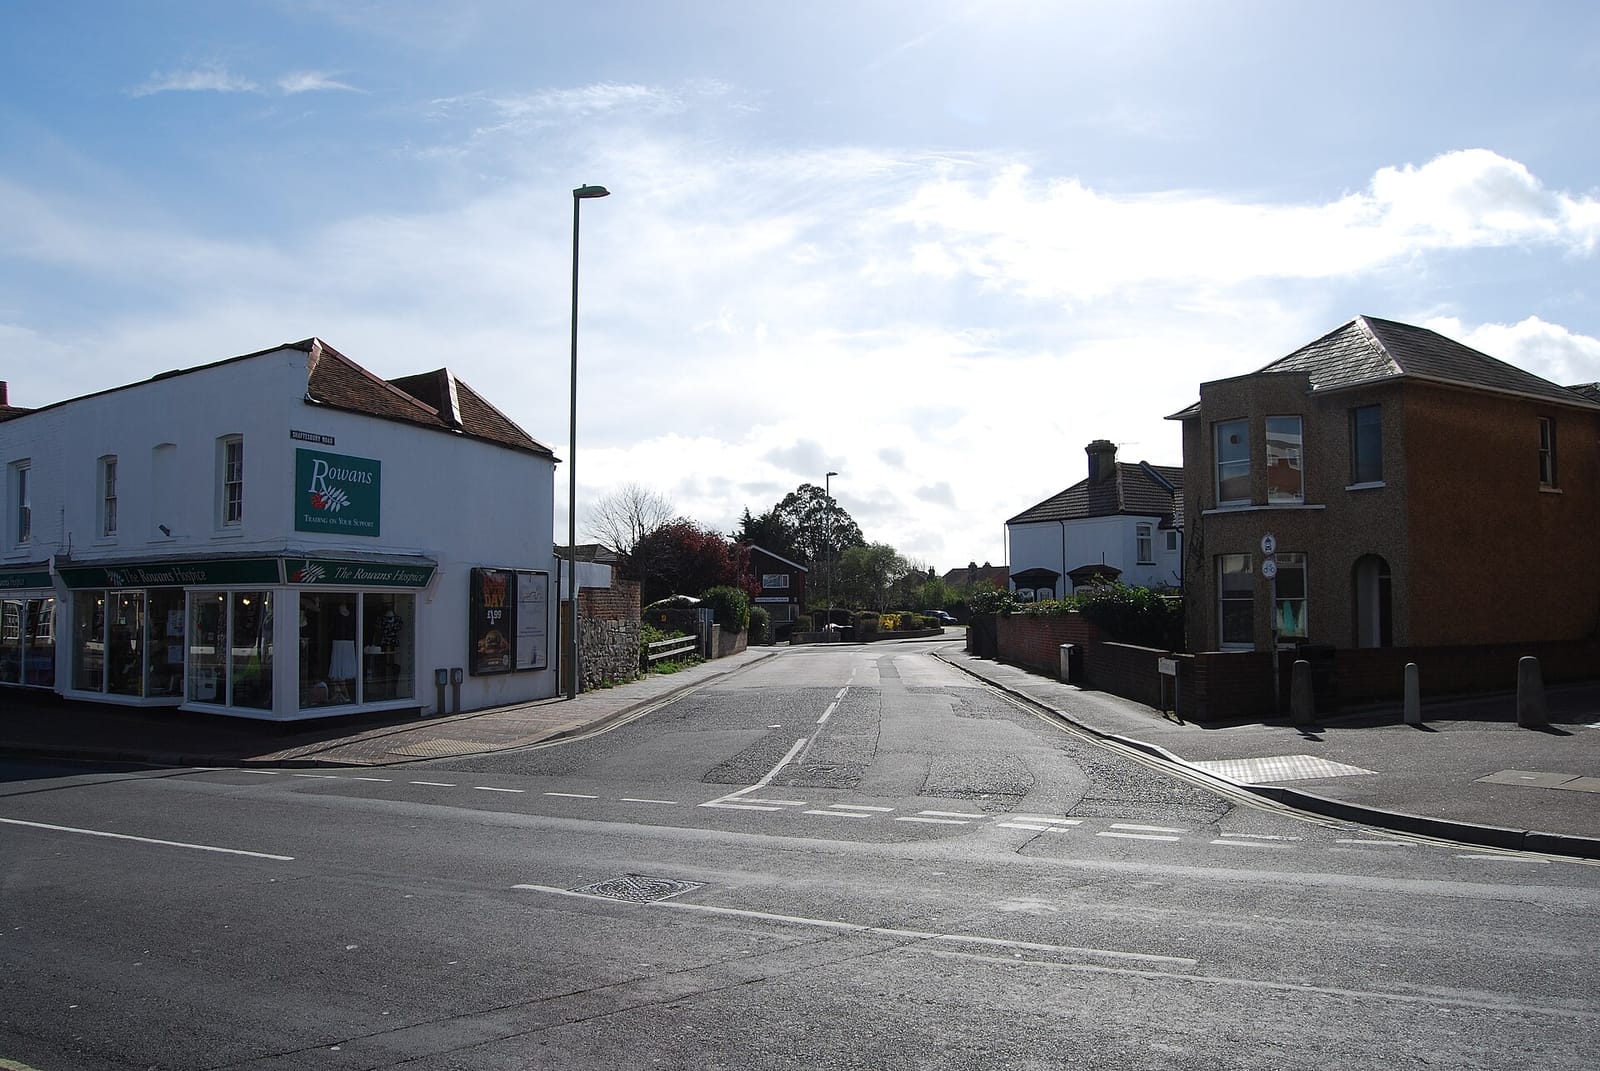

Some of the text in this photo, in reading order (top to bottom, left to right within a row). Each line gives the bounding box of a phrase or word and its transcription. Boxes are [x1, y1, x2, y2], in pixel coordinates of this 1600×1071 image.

[308, 459, 373, 493] Rowans
[121, 567, 208, 585] The Rowans Hospice
[334, 567, 426, 583] The Rowans Hospice
